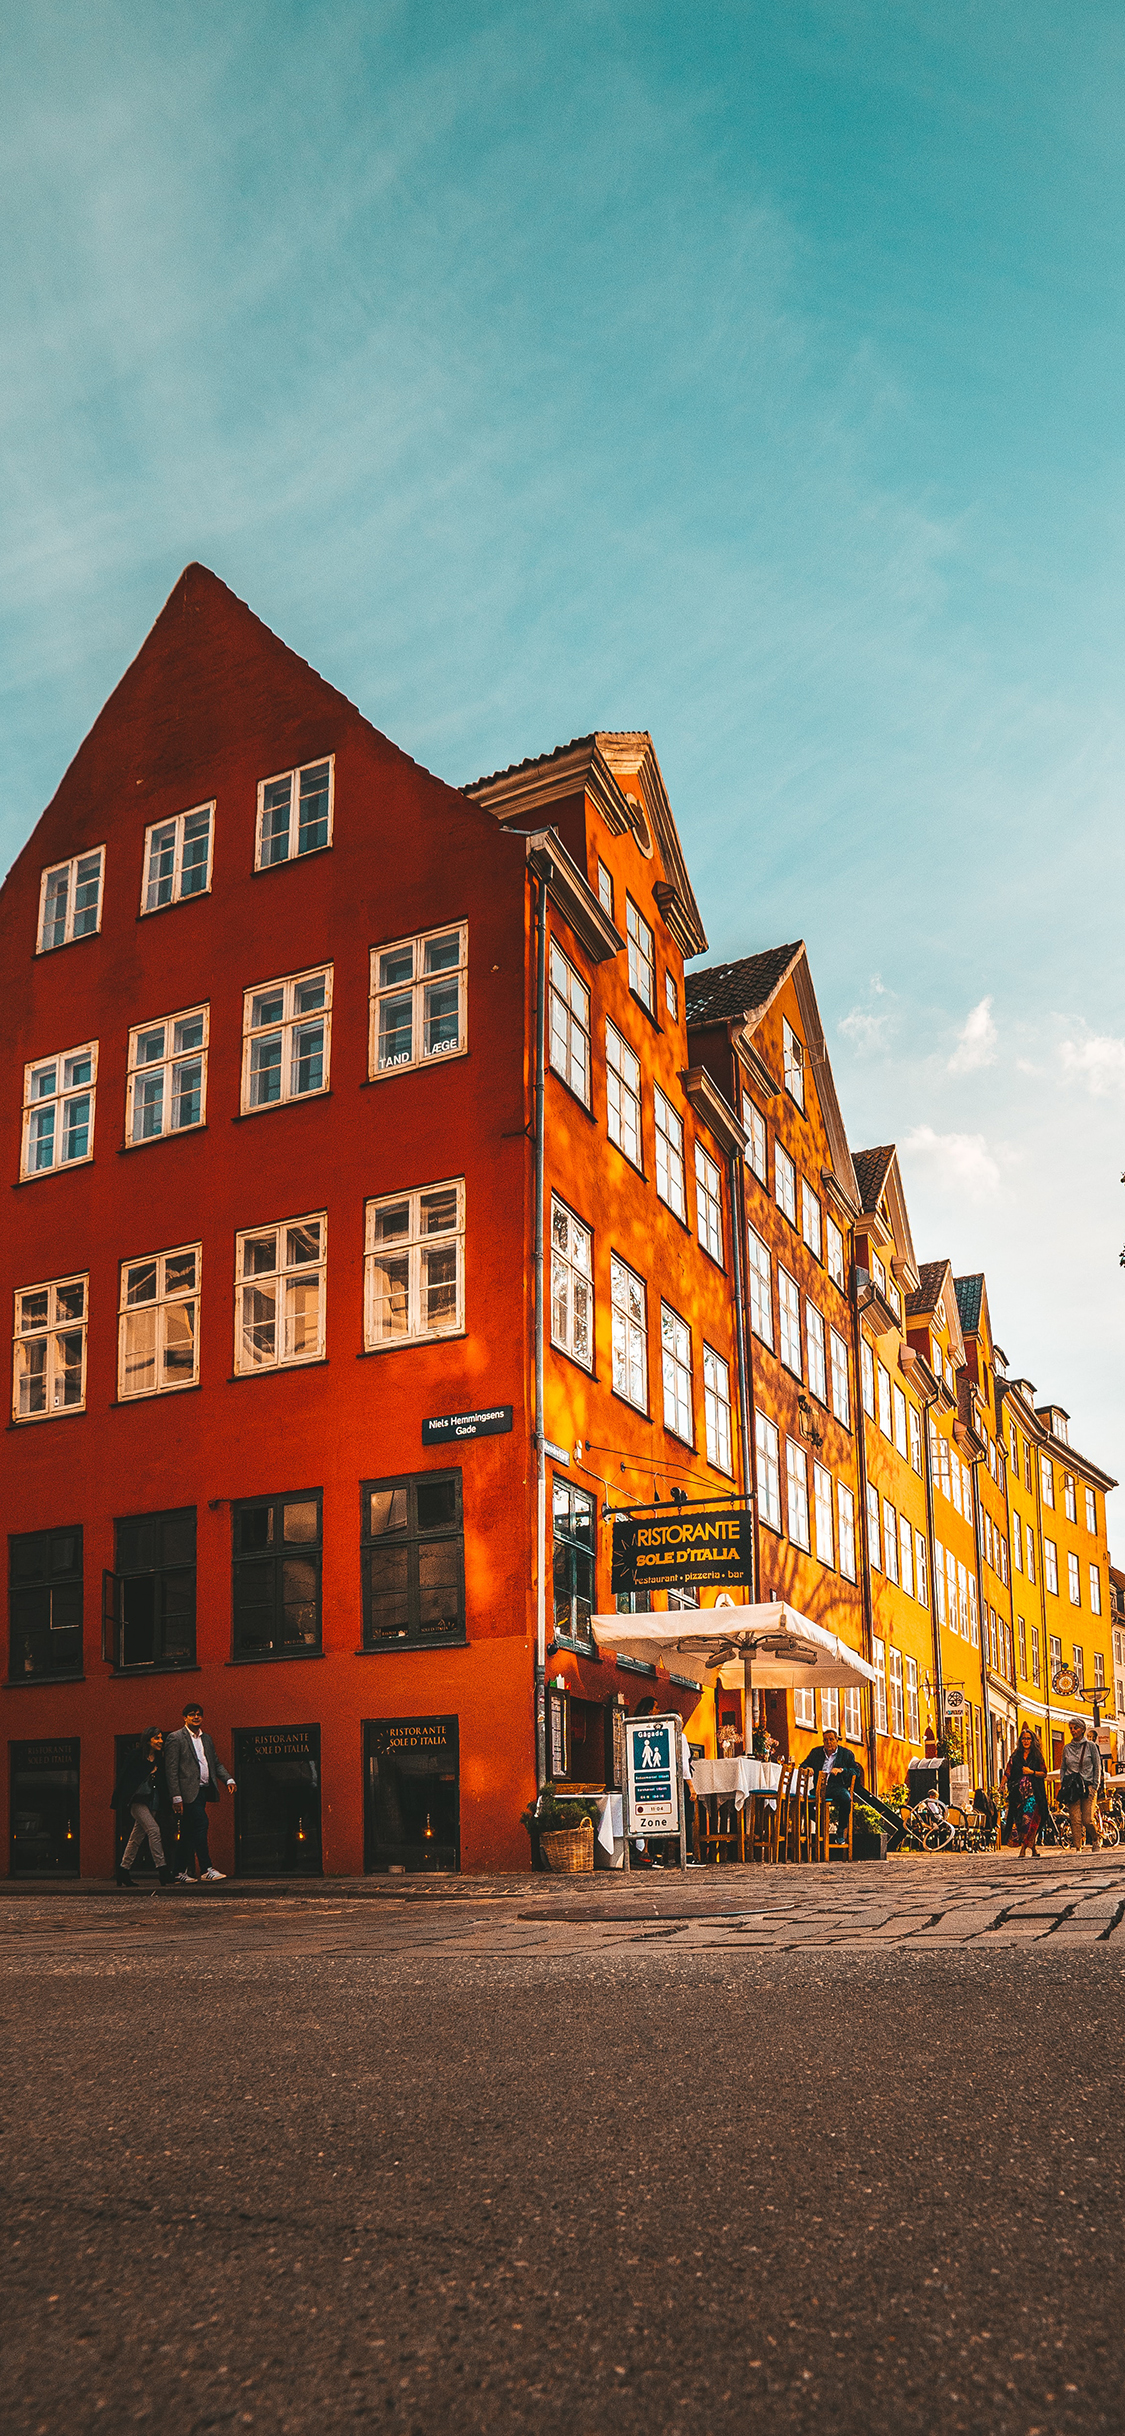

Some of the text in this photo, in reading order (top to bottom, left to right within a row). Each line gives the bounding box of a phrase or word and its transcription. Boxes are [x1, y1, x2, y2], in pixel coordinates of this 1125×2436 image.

[379, 1038, 458, 1069] TAND LÆGE
[428, 1410, 505, 1429] Niels Hemmingsens
[455, 1424, 477, 1436] Gade
[637, 1520, 741, 1547] RISTORANTE
[636, 1547, 741, 1567] SOLE D'ITALIA
[634, 1570, 744, 1585] restaurant pizzeria bar
[389, 1726, 447, 1737] RISTORANTE
[254, 1733, 309, 1744] RISTORANTE
[389, 1738, 409, 1747] SOLE
[28, 1745, 72, 1755] RISTORANTE
[254, 1745, 273, 1755] SOLE
[640, 1818, 667, 1828] Zone
